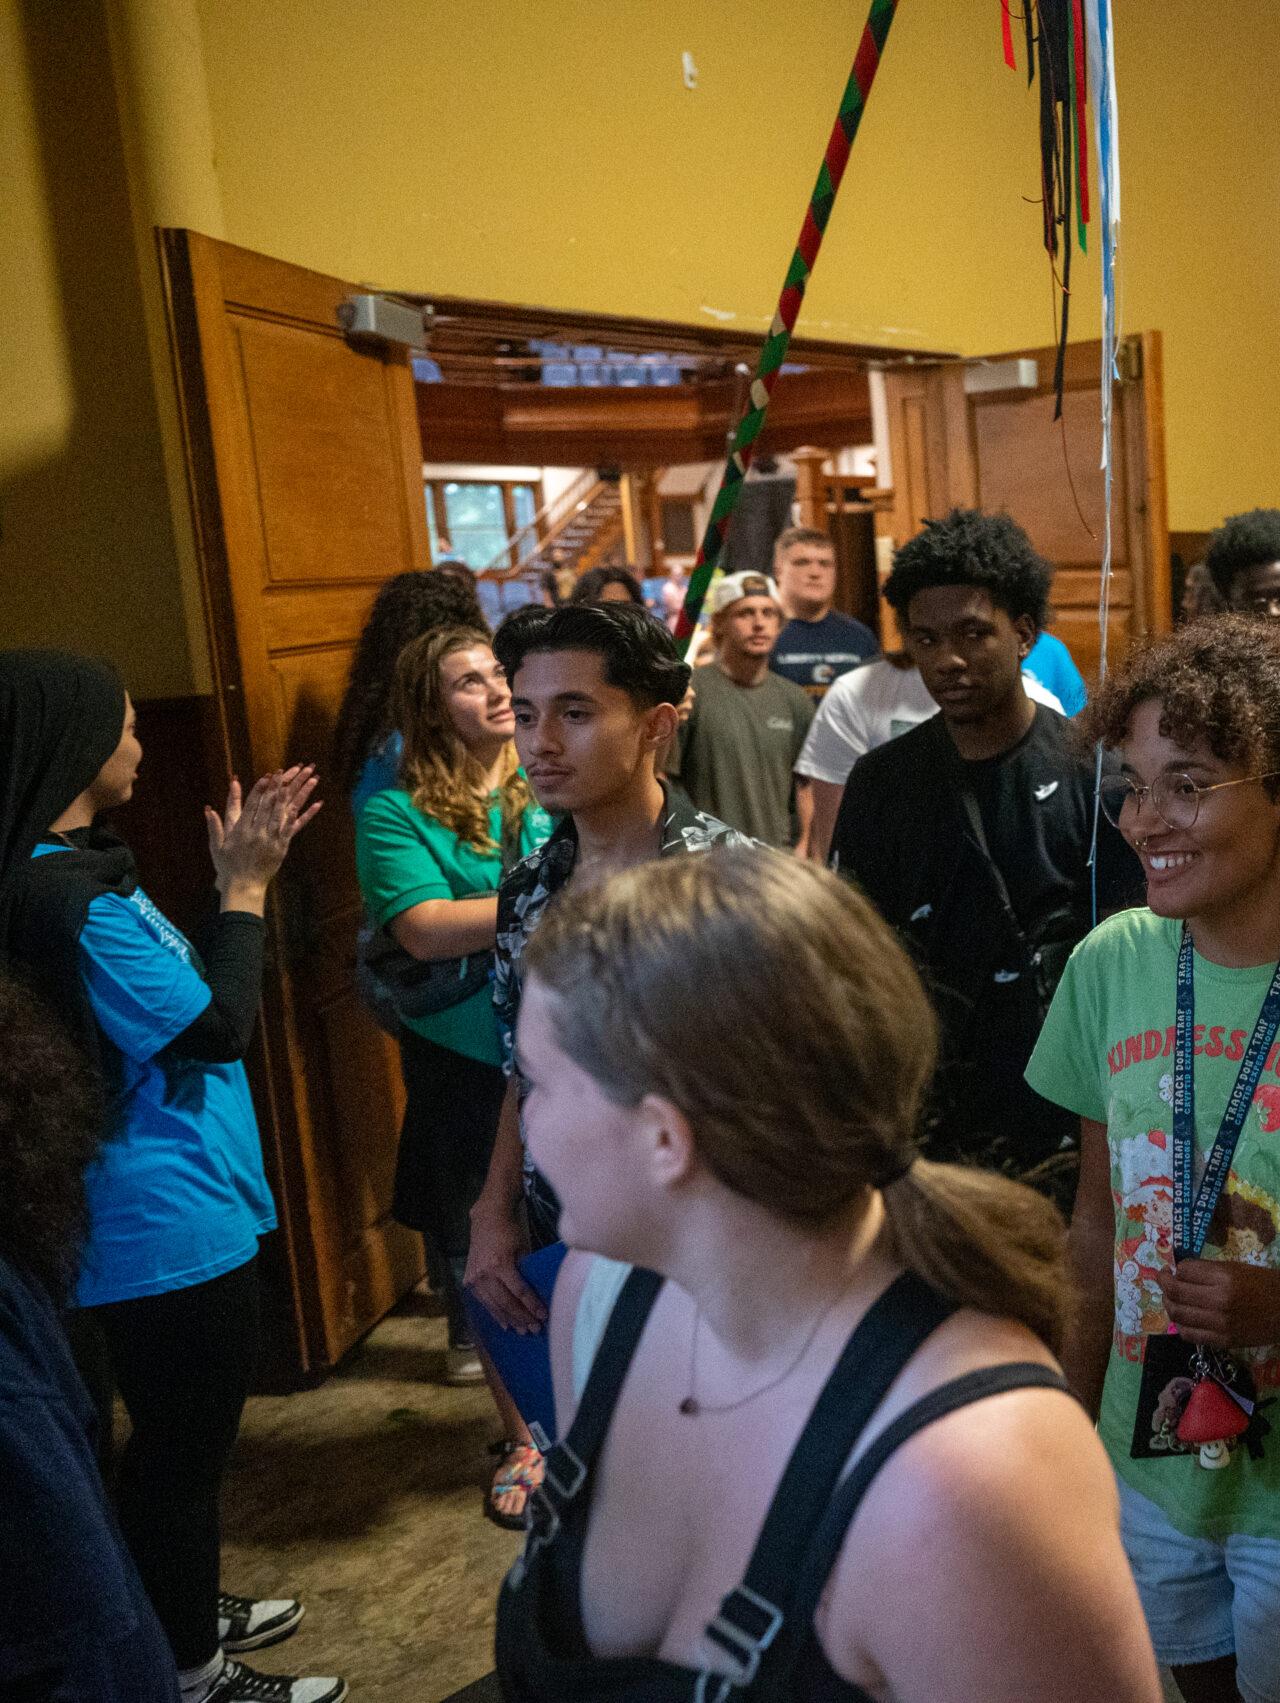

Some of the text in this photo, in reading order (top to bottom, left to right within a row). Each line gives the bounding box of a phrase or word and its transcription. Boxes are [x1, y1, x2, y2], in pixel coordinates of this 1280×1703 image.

[1178, 947, 1187, 986] TRACK
[1175, 1008, 1186, 1114] TRACK DON'T TRAP
[1184, 1009, 1192, 1071] EXPEDITIONS
[1225, 1018, 1270, 1122] TRACK DON'T TRAP
[1234, 1023, 1277, 1126] CRYPTID EXPEDITIONS
[1174, 1139, 1184, 1248] TRACK DON'T TRAP
[1183, 1140, 1191, 1203] EXPEDITIONS
[1197, 1175, 1215, 1207] DON'T
[1208, 1144, 1225, 1172] TRAP
